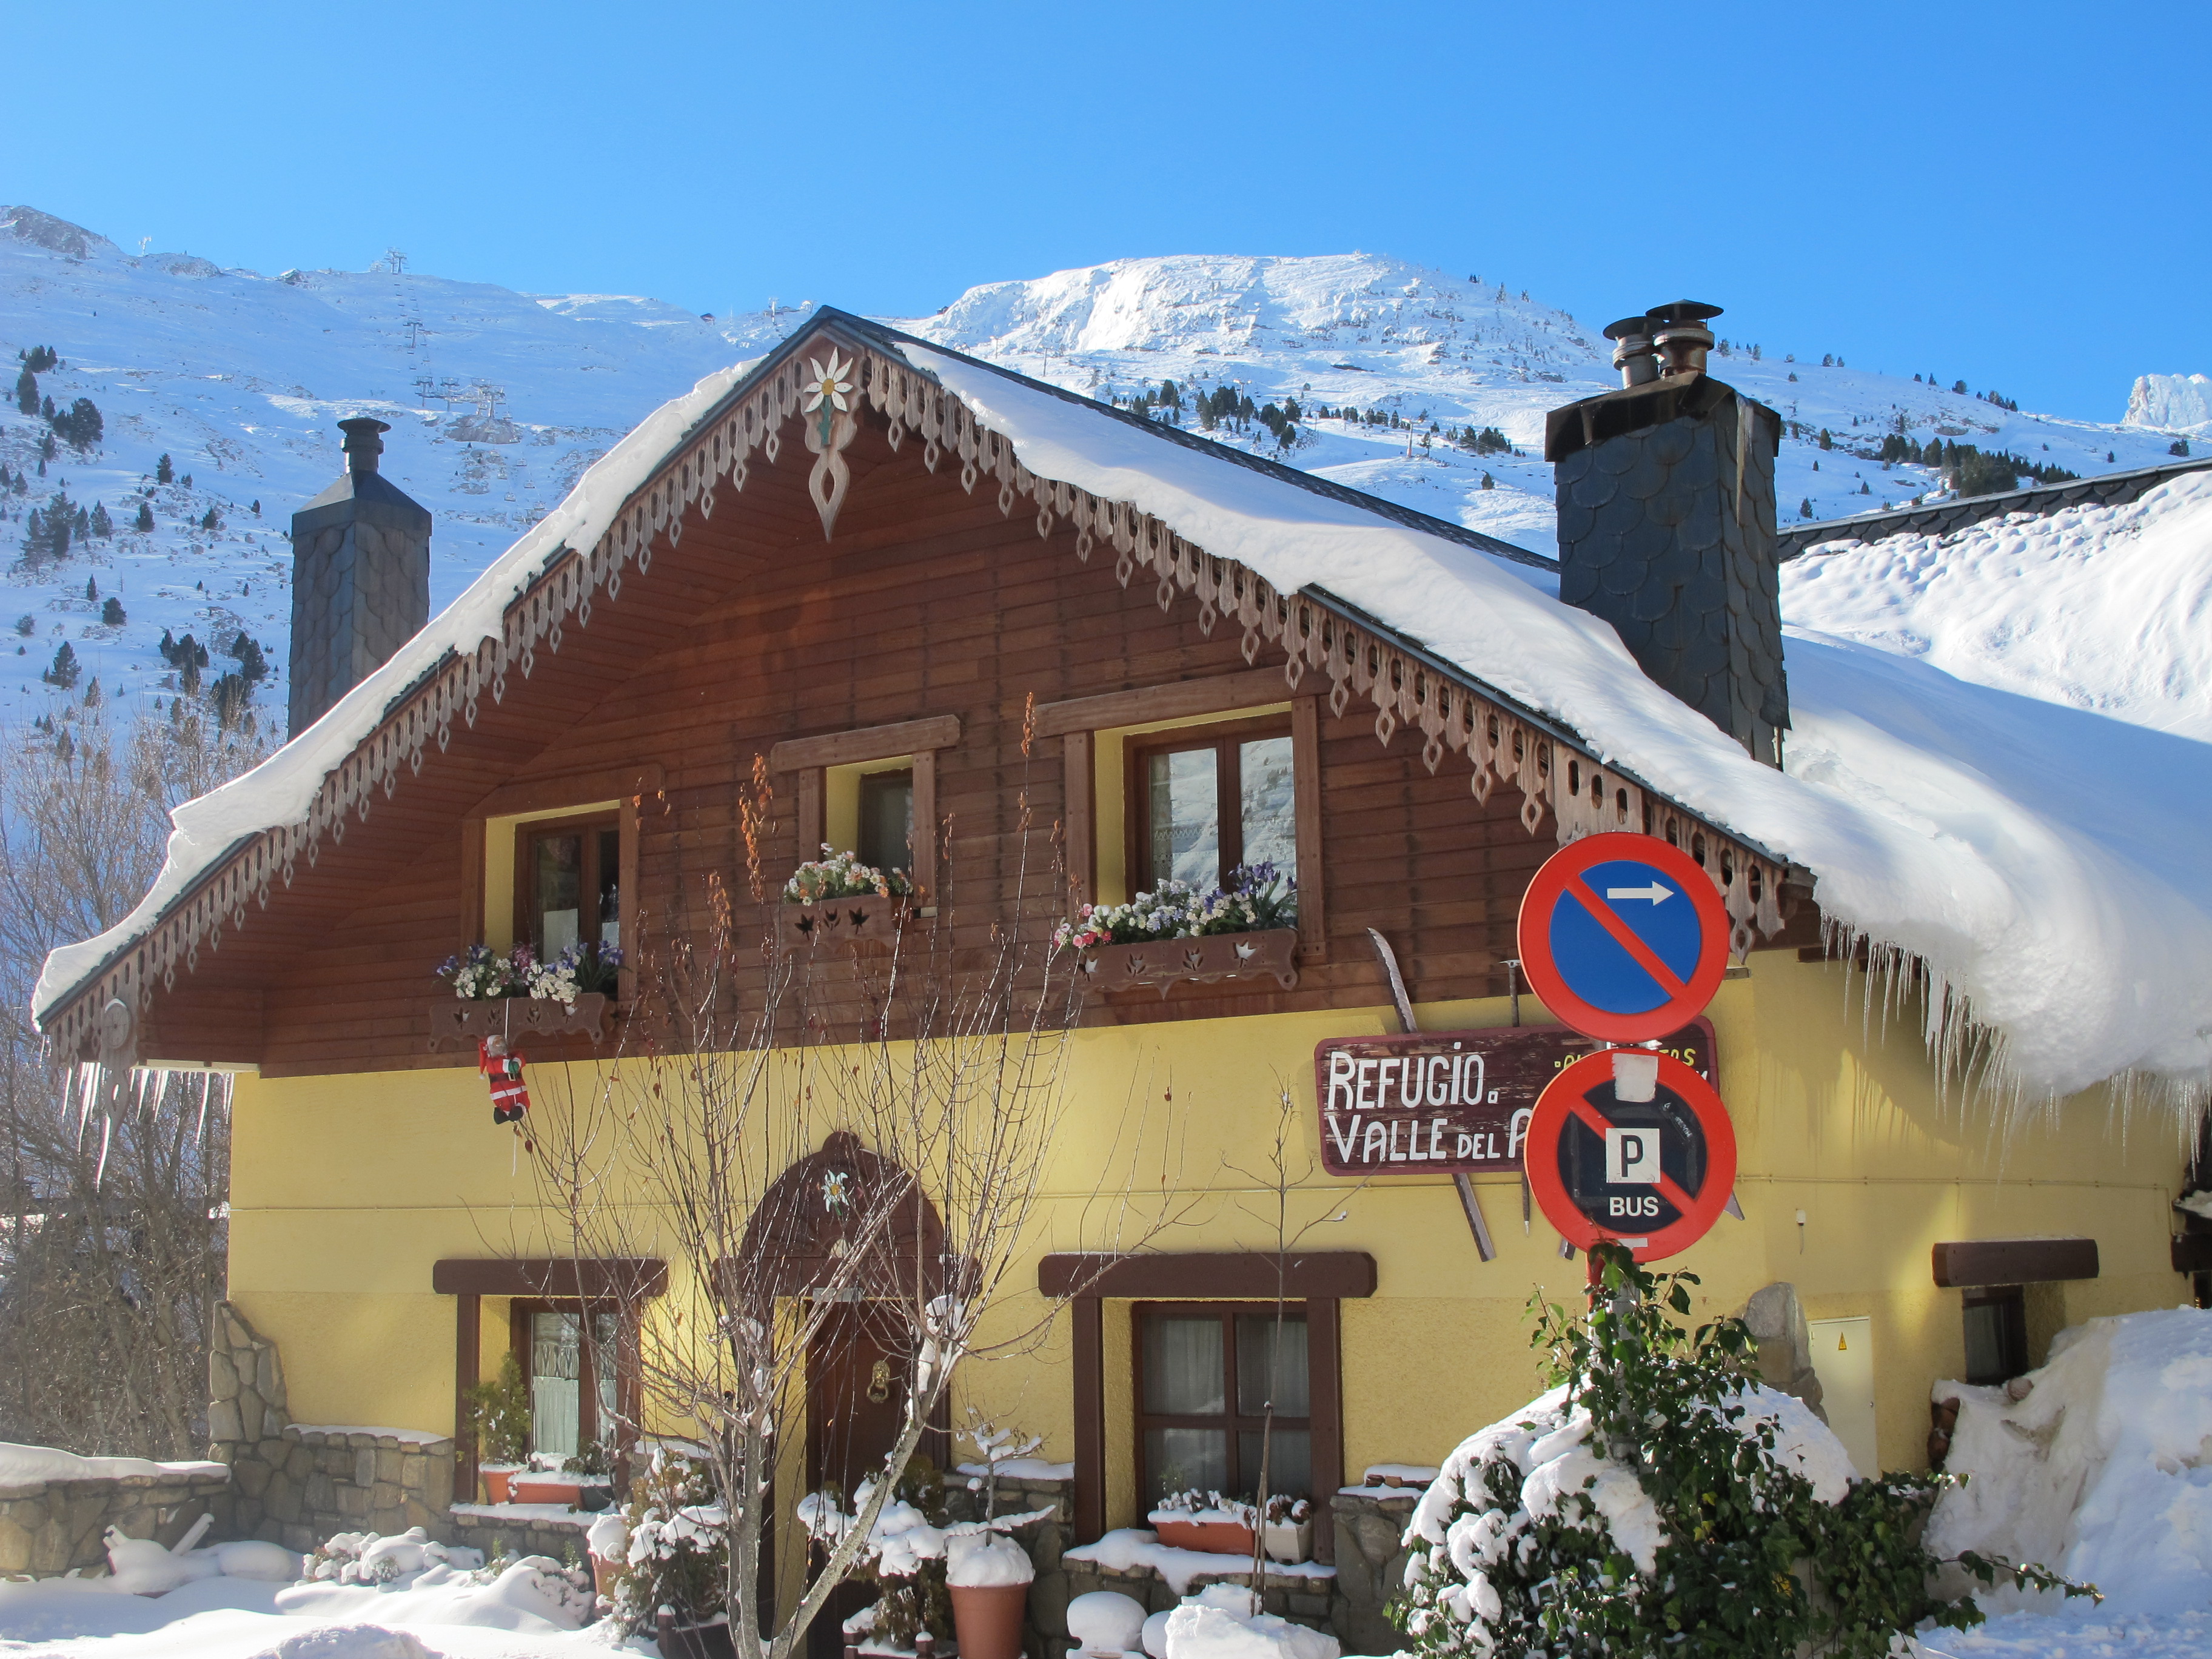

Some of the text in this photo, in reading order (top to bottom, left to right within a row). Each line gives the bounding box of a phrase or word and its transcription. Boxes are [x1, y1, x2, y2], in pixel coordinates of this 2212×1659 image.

[1328, 1114, 1448, 1163] VALLE
[1457, 1133, 1501, 1159] DEL
[1620, 1134, 1644, 1178] P
[1609, 1196, 1659, 1216] BUS
